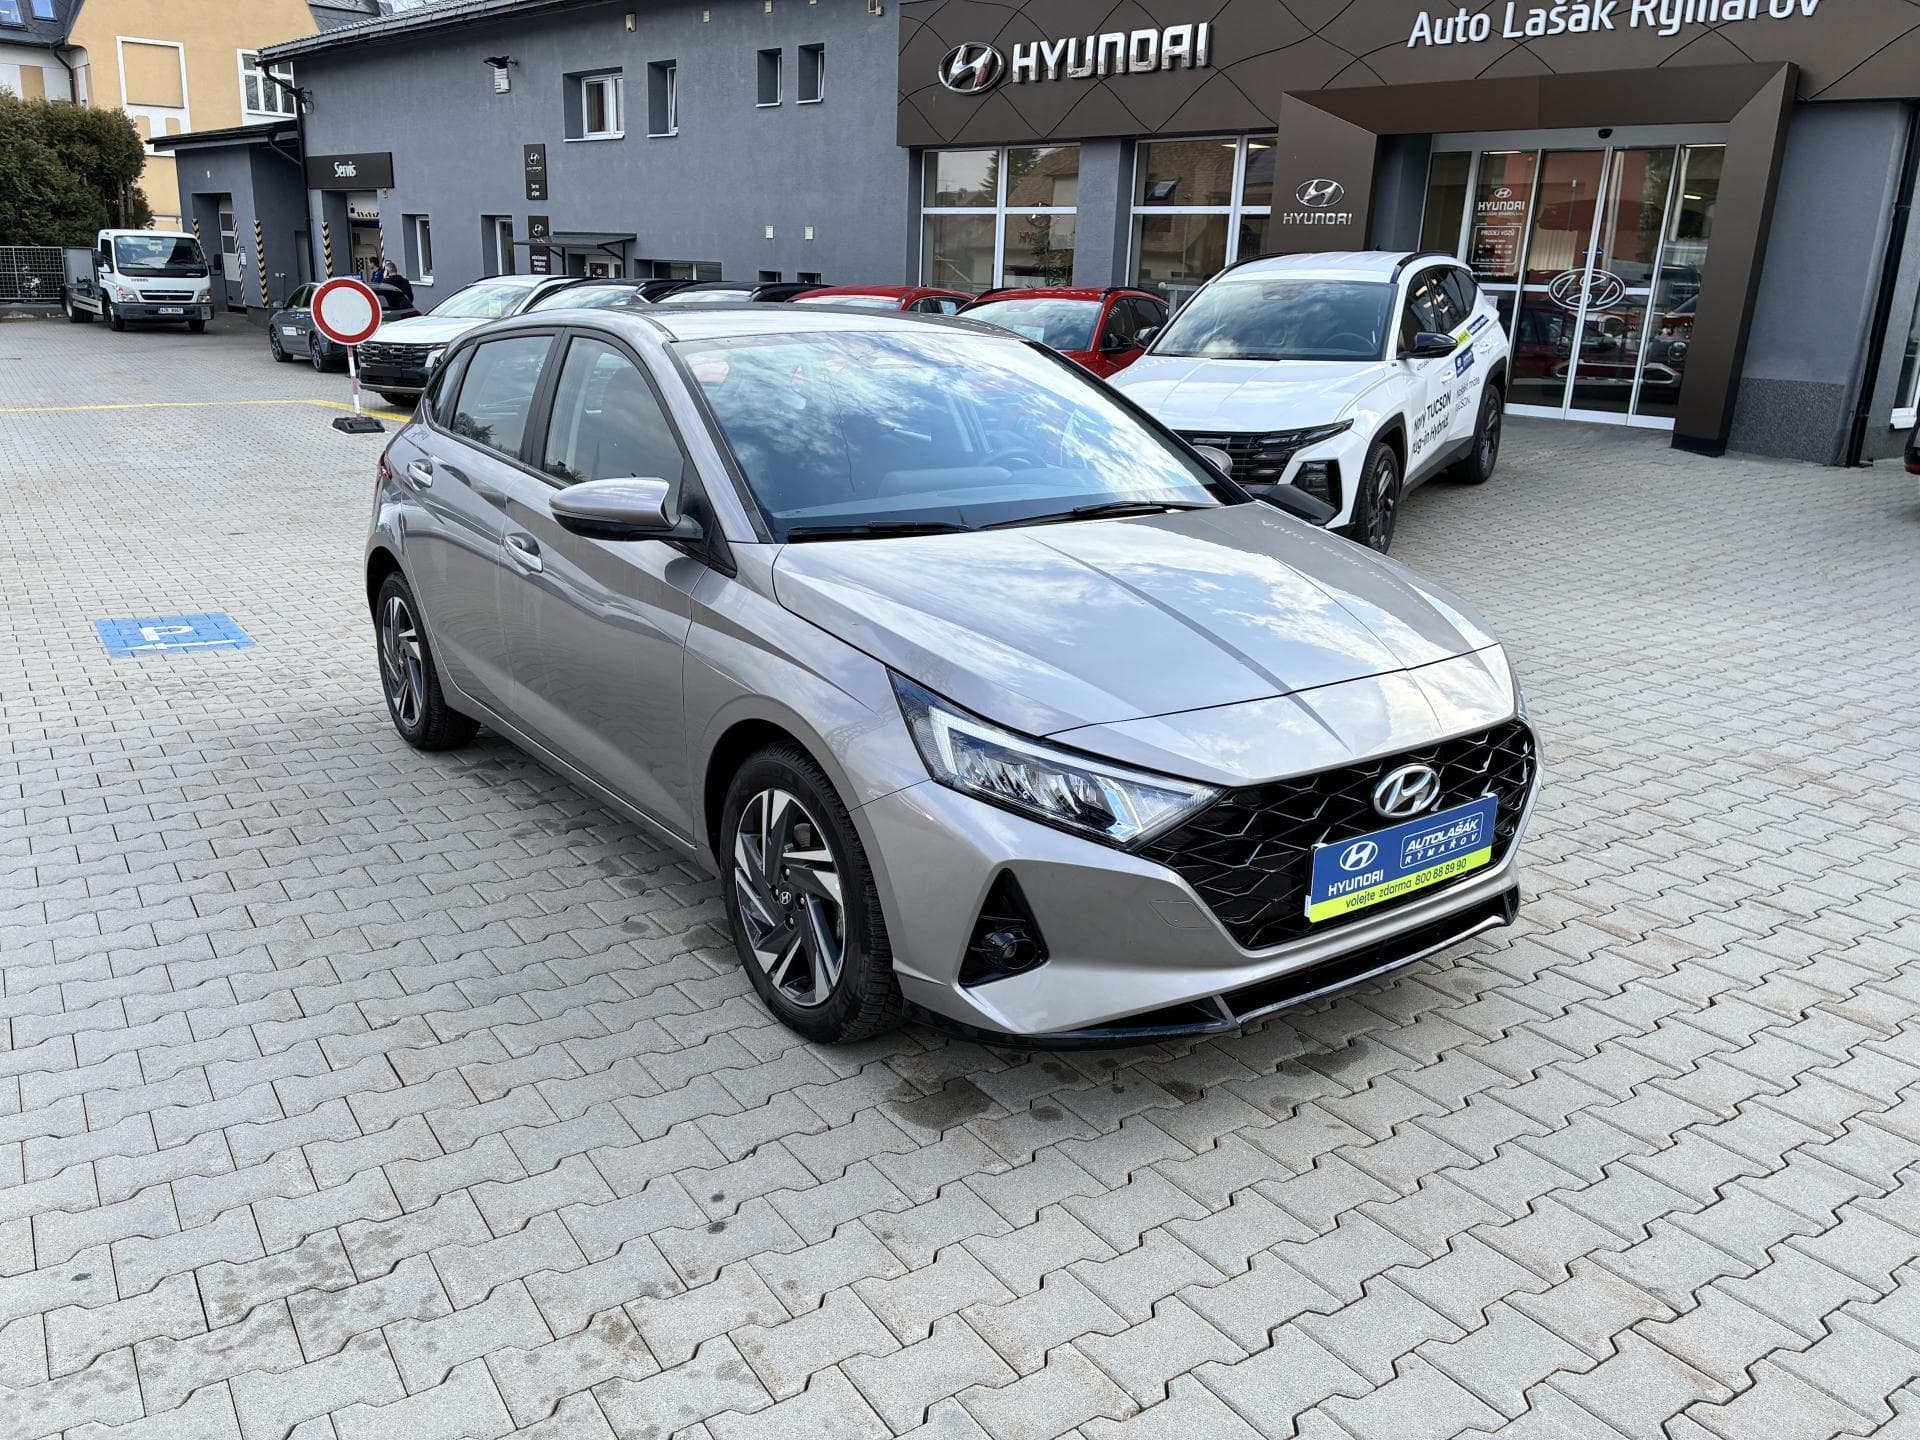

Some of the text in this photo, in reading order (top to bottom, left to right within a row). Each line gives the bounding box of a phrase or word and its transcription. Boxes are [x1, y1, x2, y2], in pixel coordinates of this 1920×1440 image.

[1407, 8, 1490, 48] Auto
[1503, 0, 1617, 38] Lašák
[1013, 22, 1209, 83] HYUNDAI
[334, 161, 357, 177] Servis
[1283, 212, 1353, 225] HYUNDAI
[1478, 201, 1525, 211] HYUNDAI
[1427, 390, 1452, 420] TUCSON
[1405, 818, 1480, 853] AUTOLAŠÁK
[1405, 833, 1478, 864] RÝMAŘOV
[1328, 869, 1384, 897] HYUNDAI
[1345, 858, 1467, 908] volejte zdarma 800 88 89 90
